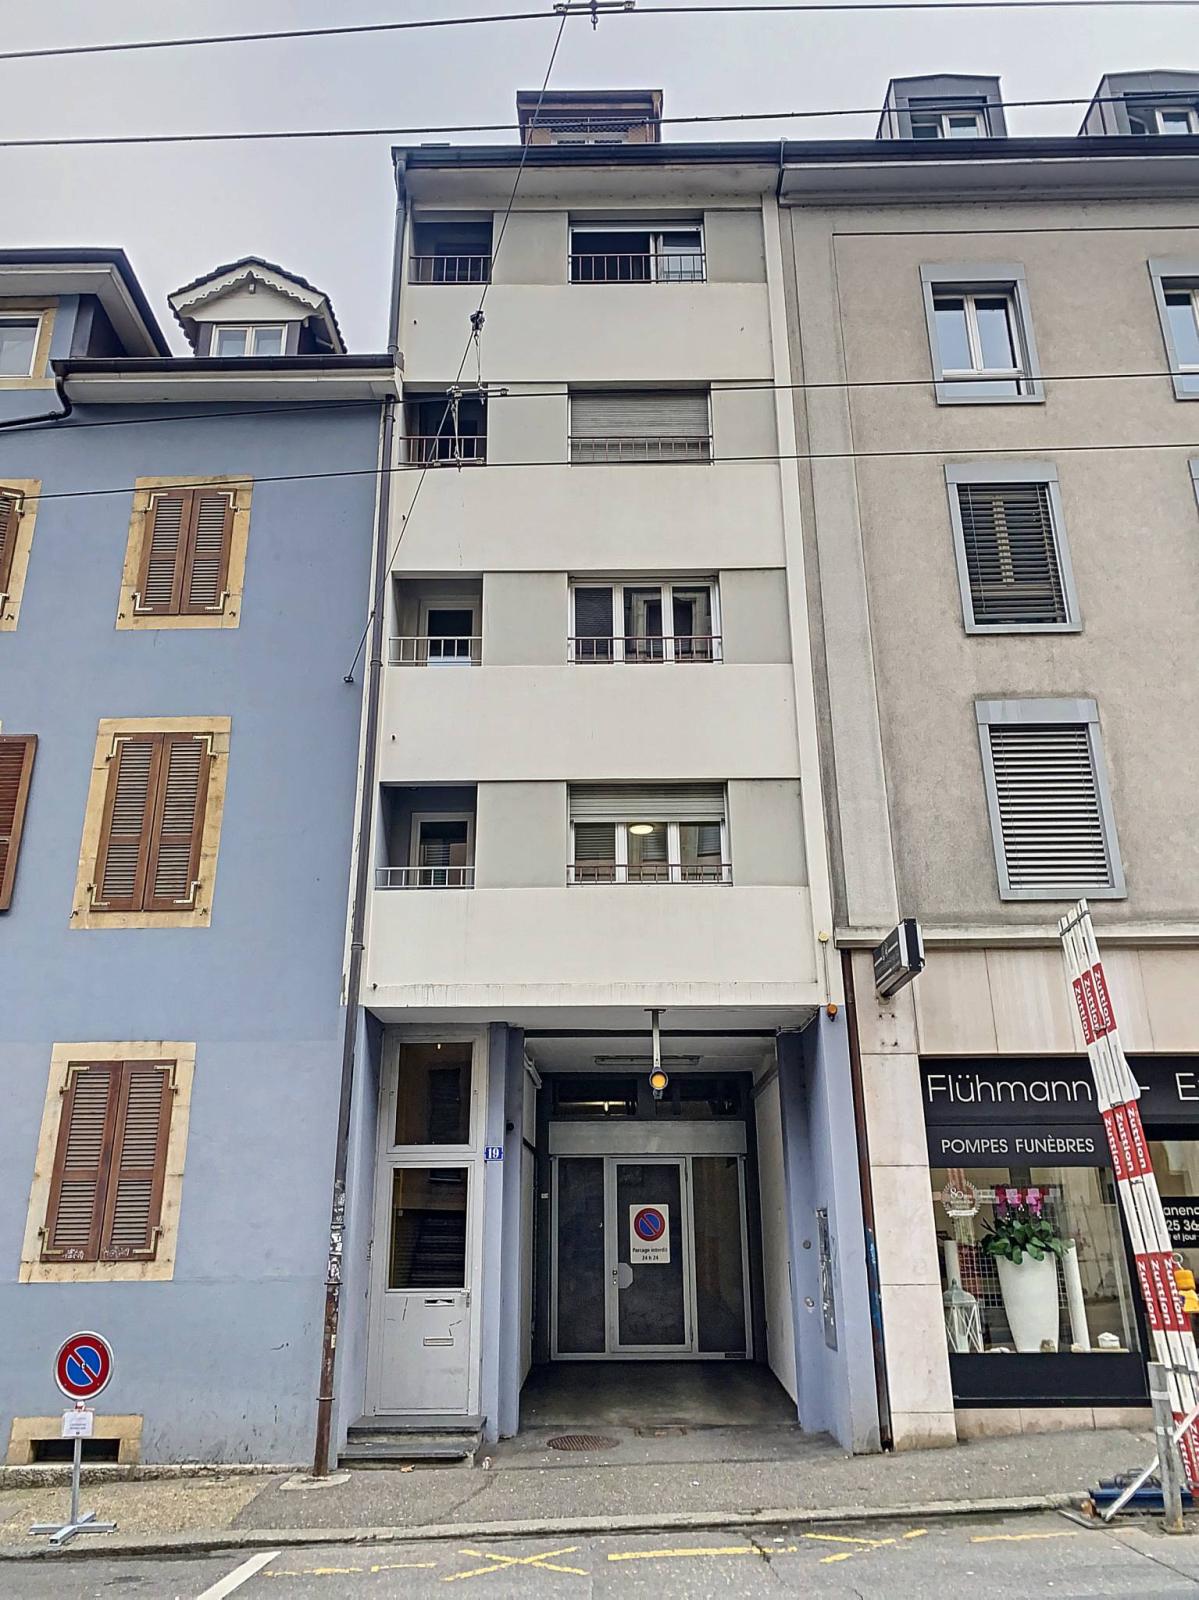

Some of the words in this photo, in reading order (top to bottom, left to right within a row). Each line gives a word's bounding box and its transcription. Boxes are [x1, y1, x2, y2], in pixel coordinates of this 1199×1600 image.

[927, 1074, 1092, 1103] Flühmann
[1175, 1072, 1199, 1101] E
[941, 1138, 1008, 1154] POMPES
[1015, 1134, 1095, 1154] FUNÈBRES
[488, 1147, 499, 1159] 19
[1163, 1206, 1199, 1216] anenc
